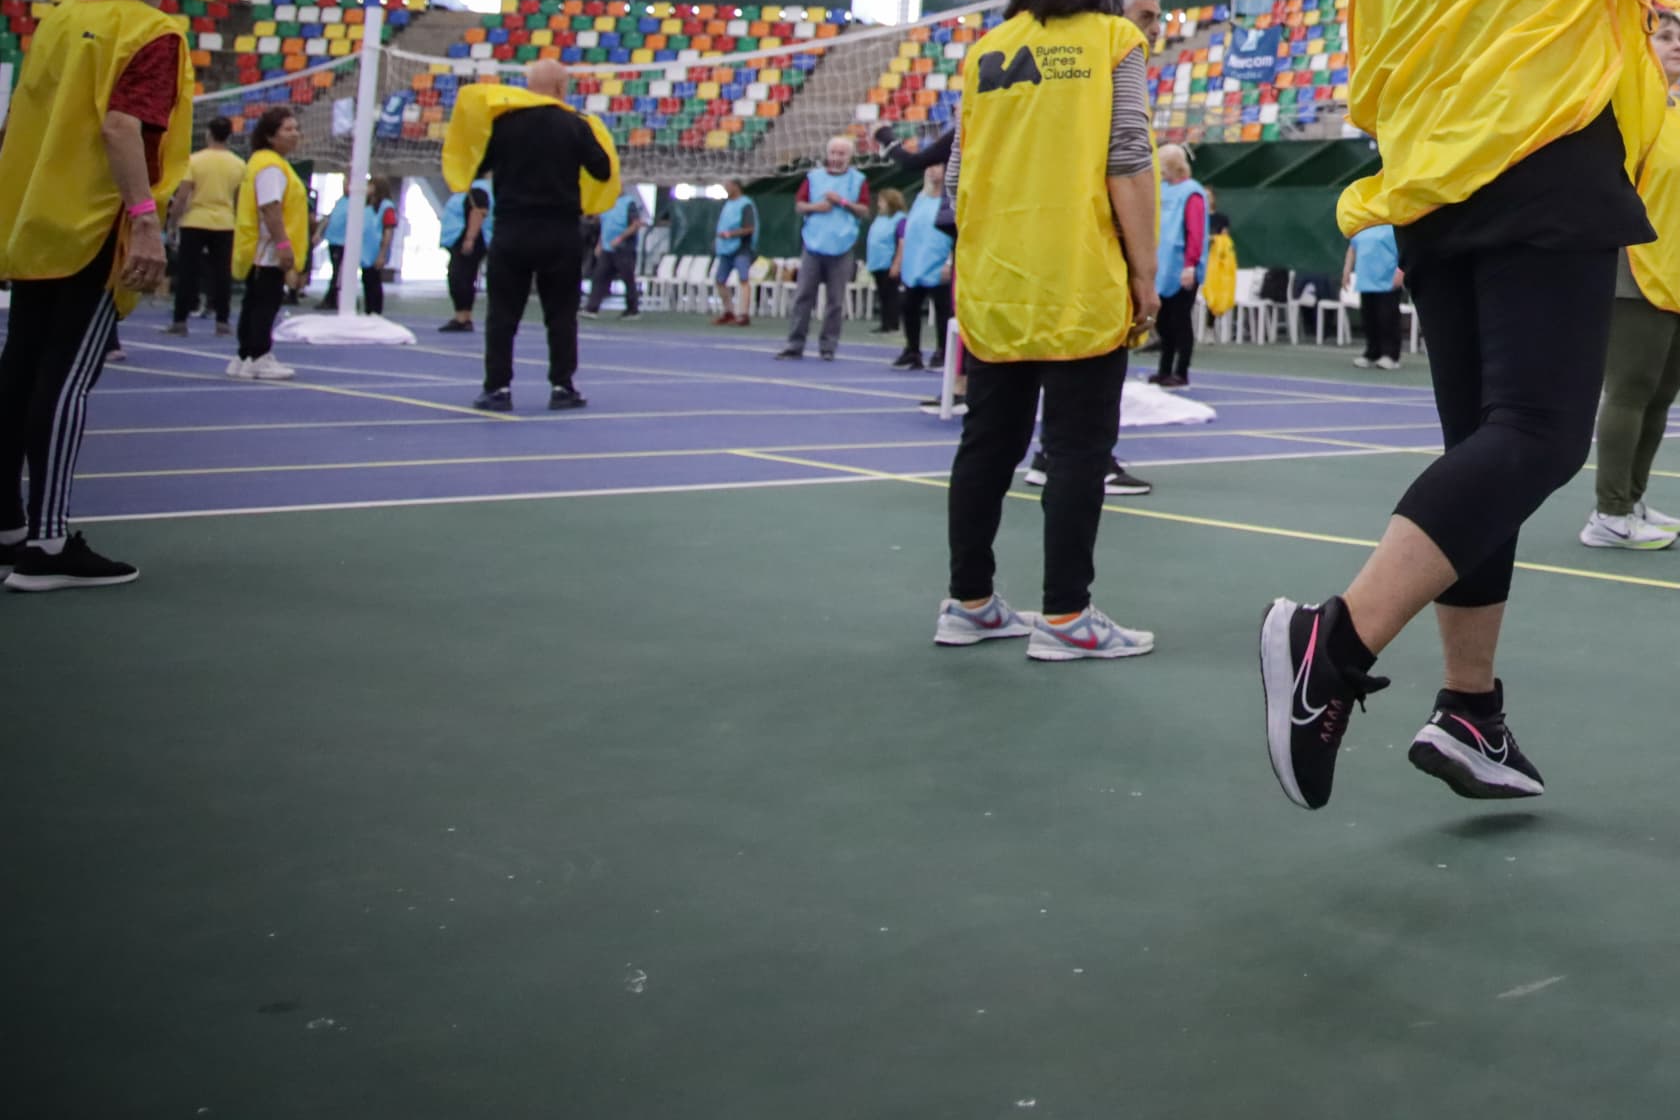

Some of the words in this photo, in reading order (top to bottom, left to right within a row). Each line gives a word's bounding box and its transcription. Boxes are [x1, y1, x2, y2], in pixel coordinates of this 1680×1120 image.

[1036, 46, 1083, 56] Buenos
[1041, 56, 1076, 67] Aires
[1044, 68, 1091, 80] Ciudad
